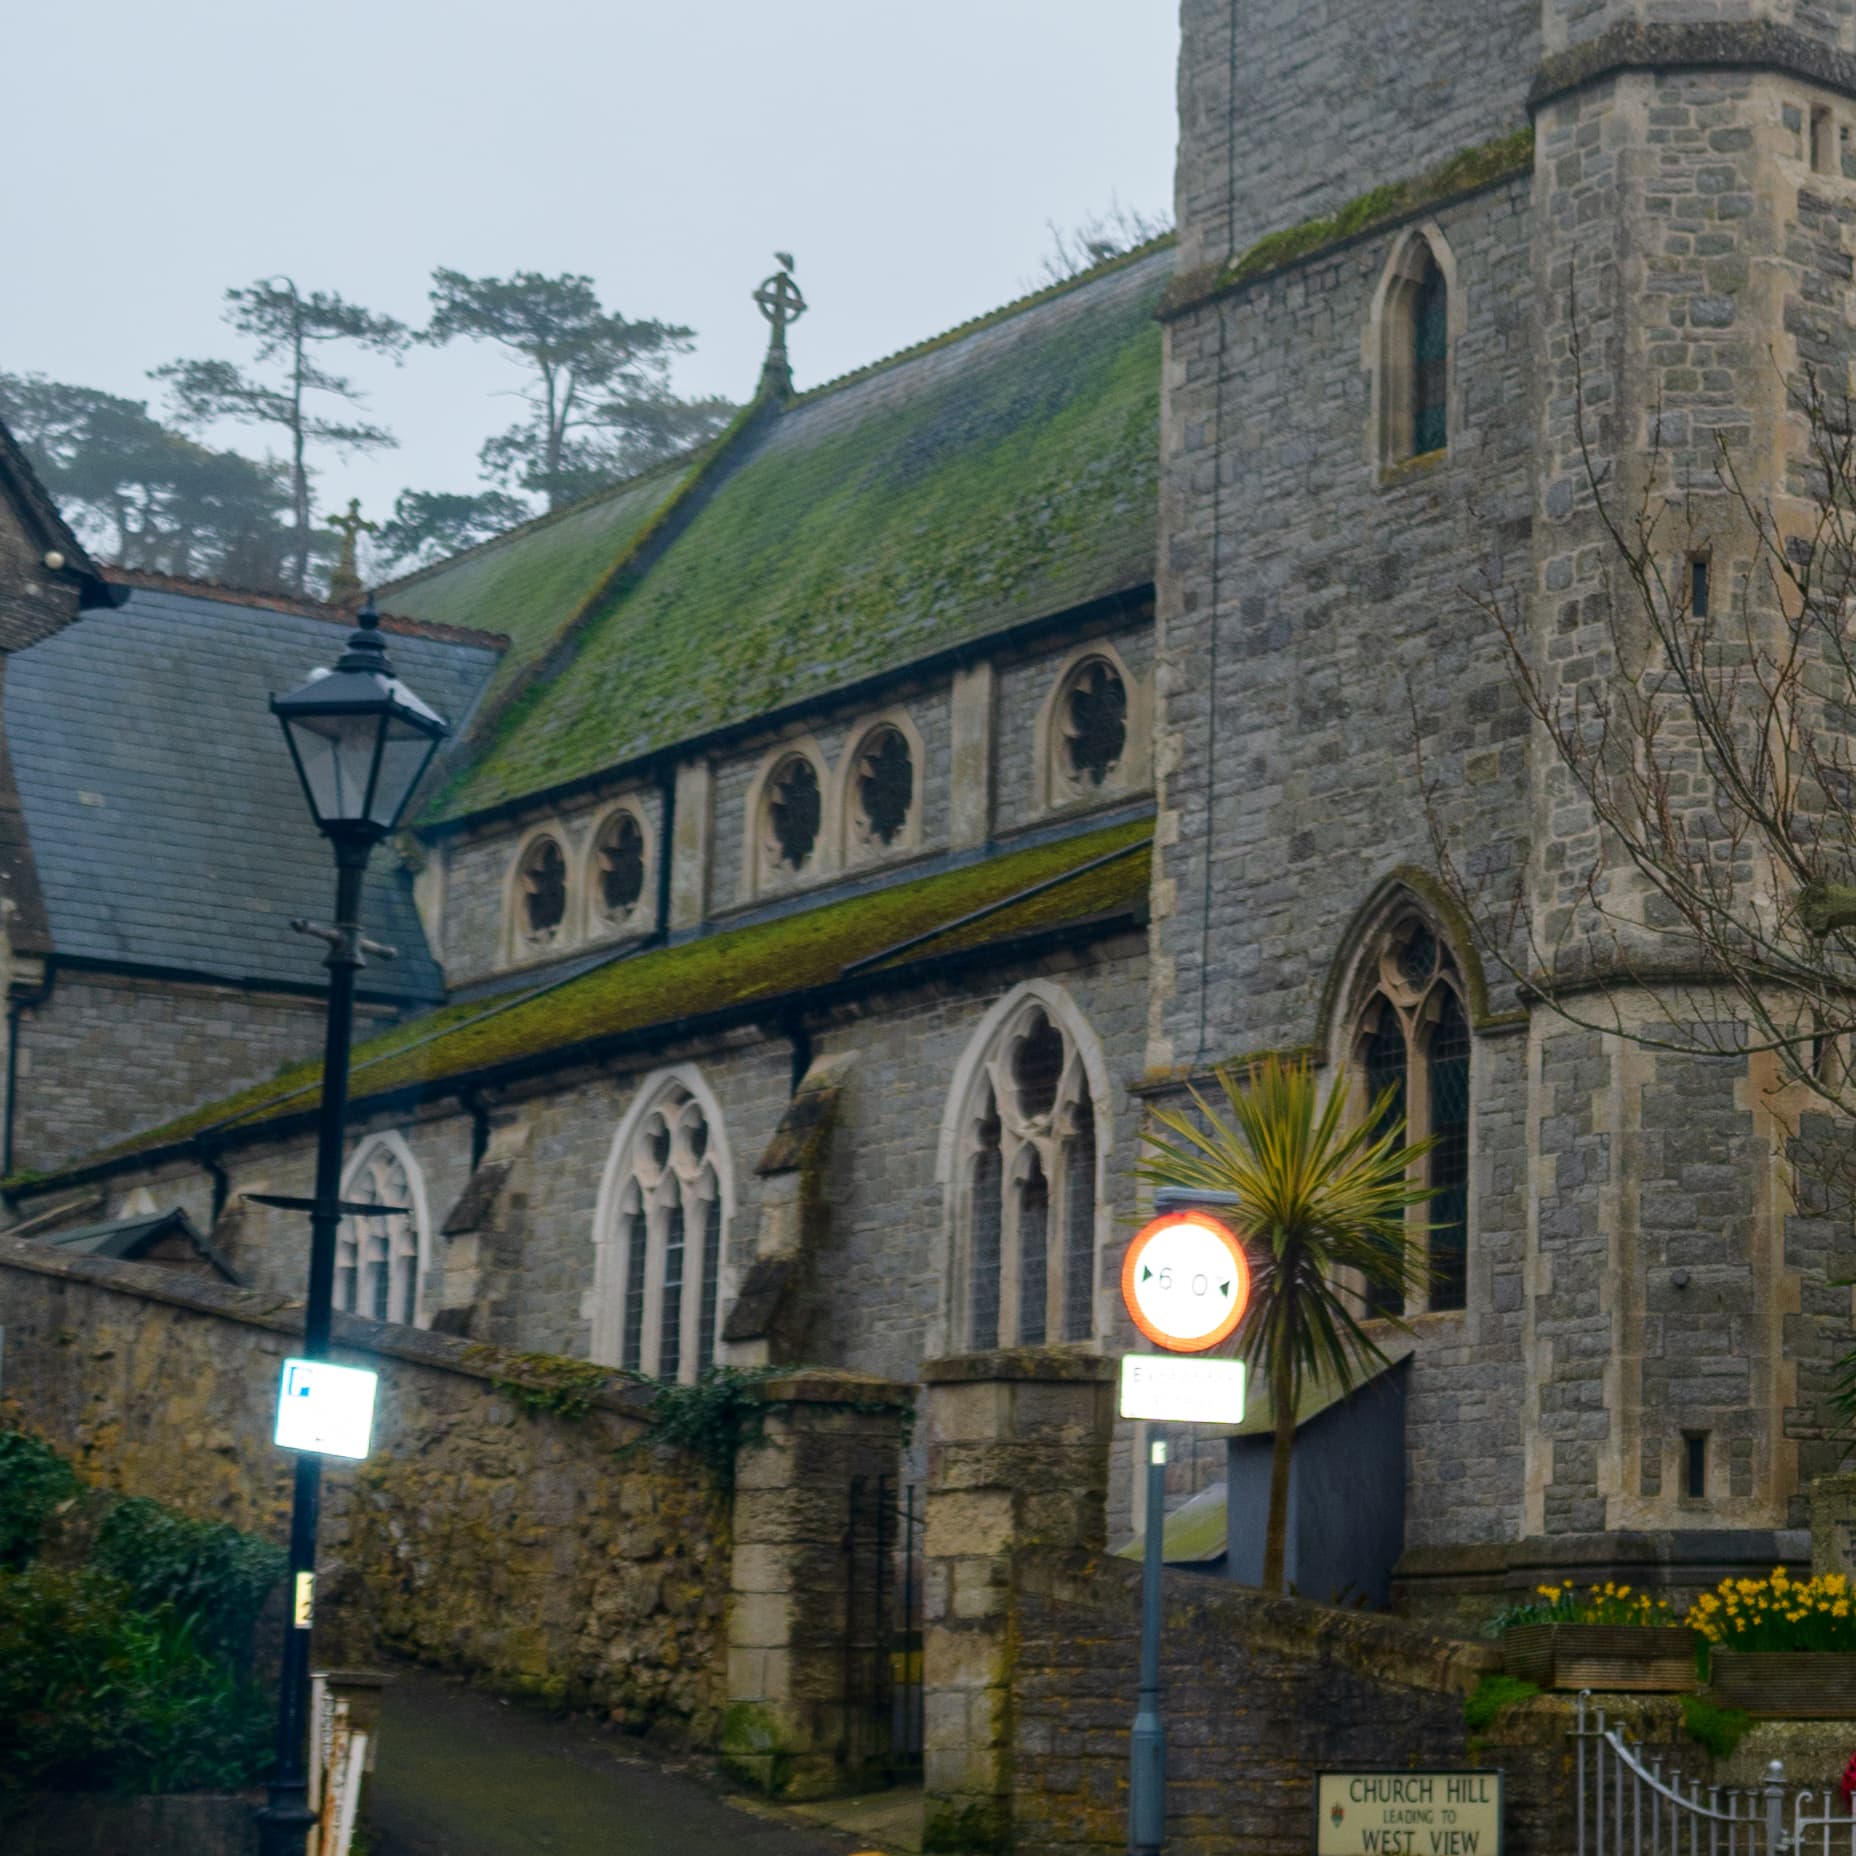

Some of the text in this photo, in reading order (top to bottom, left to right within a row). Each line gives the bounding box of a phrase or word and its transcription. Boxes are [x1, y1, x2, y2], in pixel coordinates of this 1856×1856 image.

[1350, 1778, 1489, 1803] CHURCH HILL
[1383, 1809, 1457, 1824] LEADING TO
[1362, 1830, 1480, 1855] WEST VIEW
